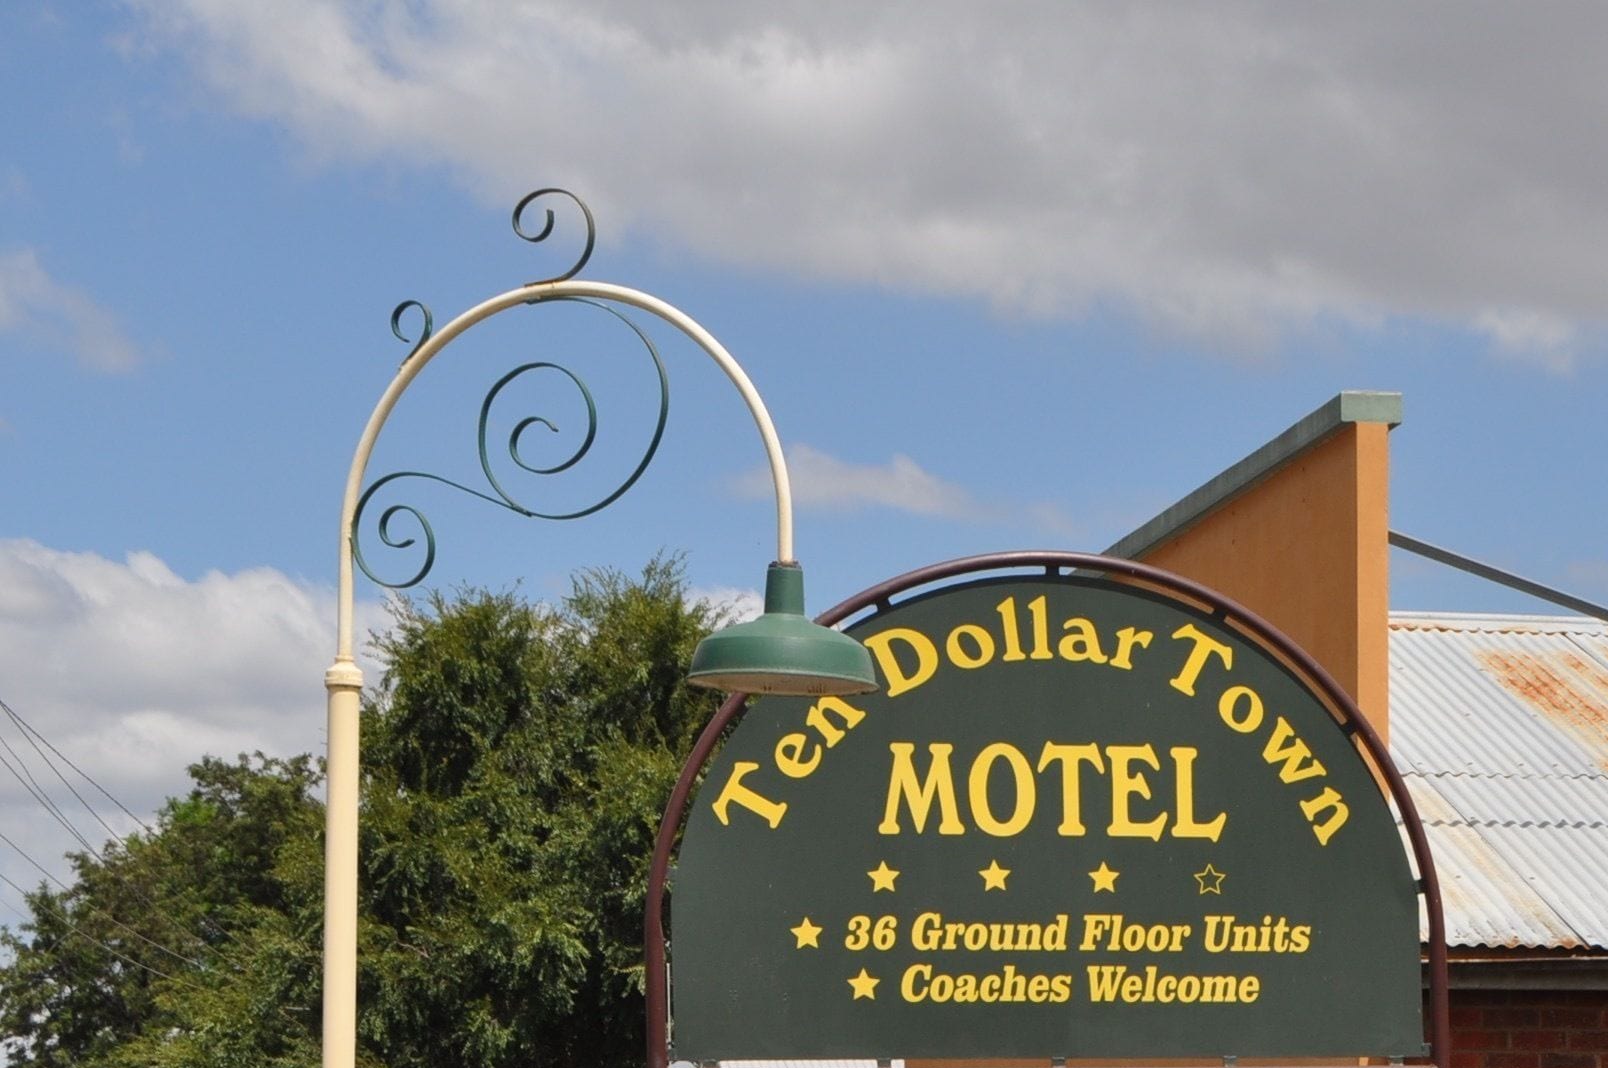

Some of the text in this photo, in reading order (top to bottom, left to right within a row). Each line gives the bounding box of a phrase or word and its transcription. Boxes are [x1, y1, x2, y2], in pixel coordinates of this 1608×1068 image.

[711, 595, 1352, 846] Ten Dollar Town
[877, 741, 1228, 843] MOTEL
[844, 913, 1311, 953] 36 Ground Floor Units
[899, 965, 1261, 1004] Coaches Welcome
